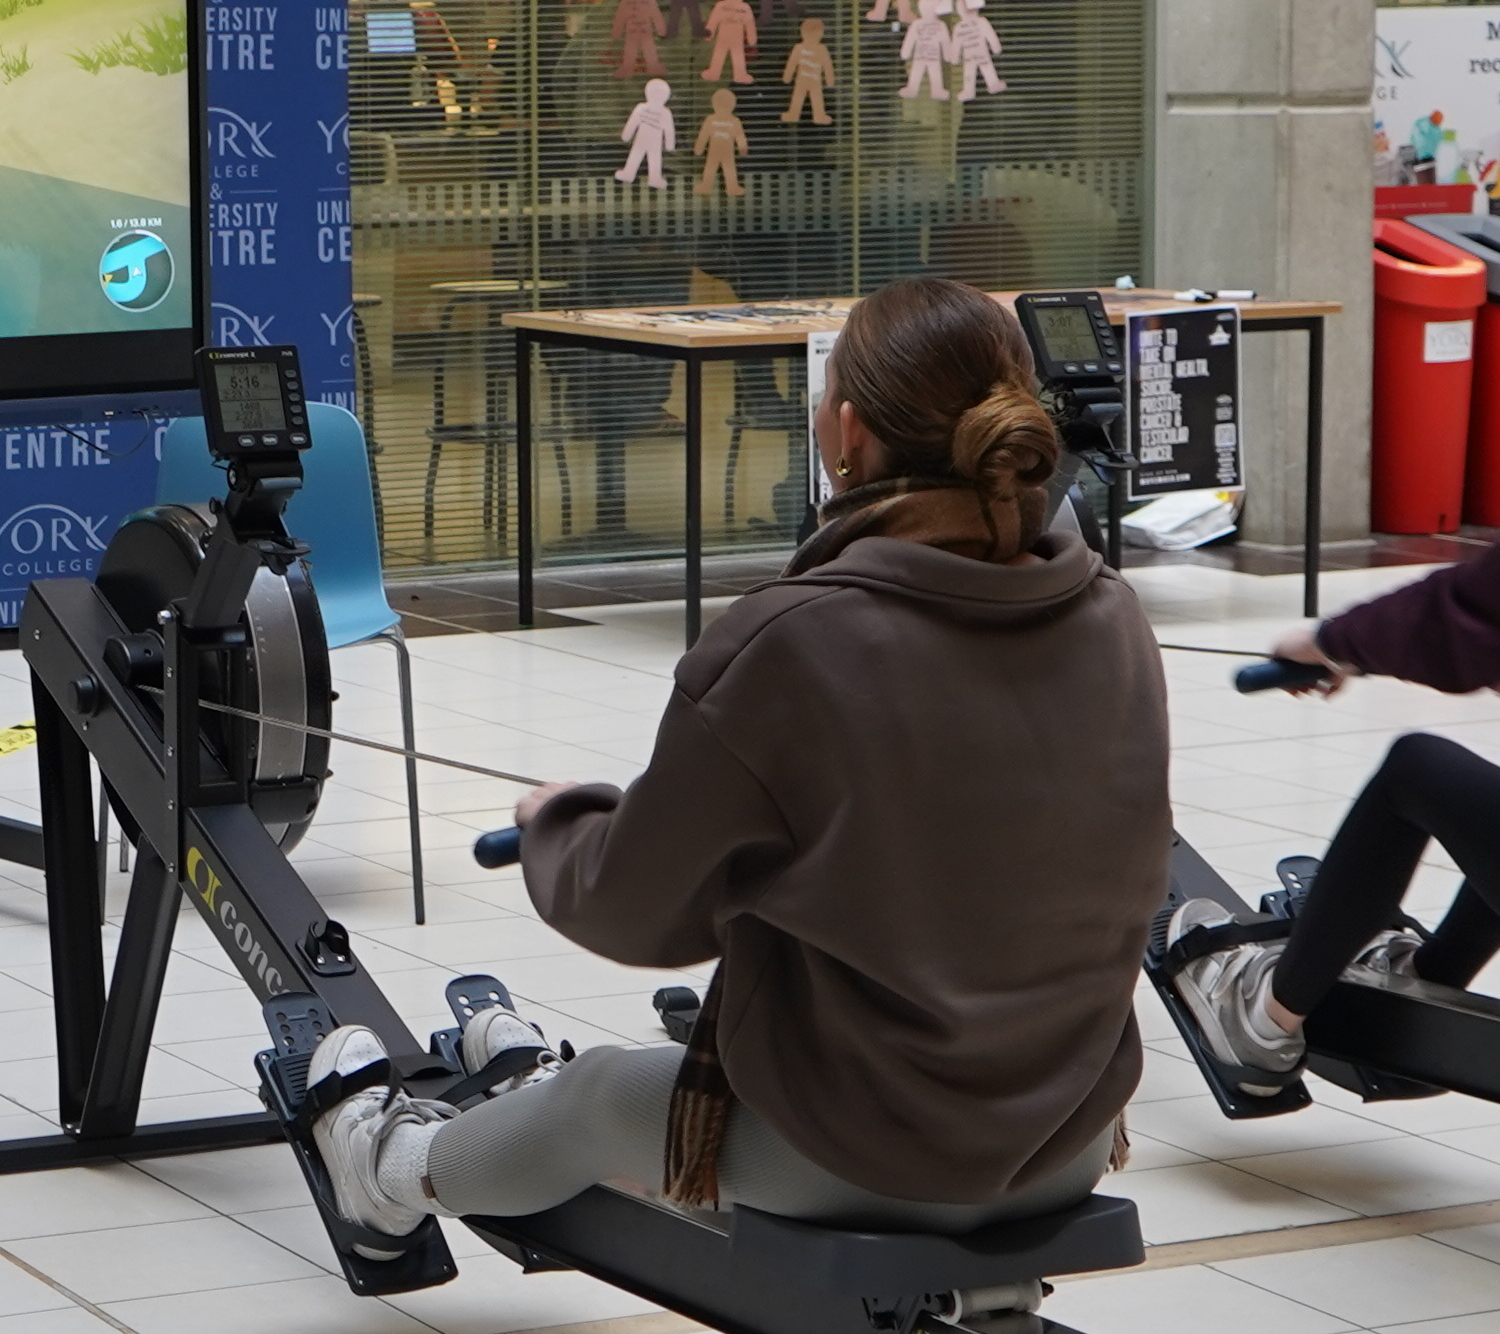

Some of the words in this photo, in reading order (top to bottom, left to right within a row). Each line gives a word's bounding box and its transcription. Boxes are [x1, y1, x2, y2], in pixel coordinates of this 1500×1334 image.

[205, 7, 278, 32] ERSITY
[210, 183, 223, 200] &
[148, 217, 162, 226] KM
[3, 558, 94, 577] COLLEGE
[220, 900, 291, 996] conc
